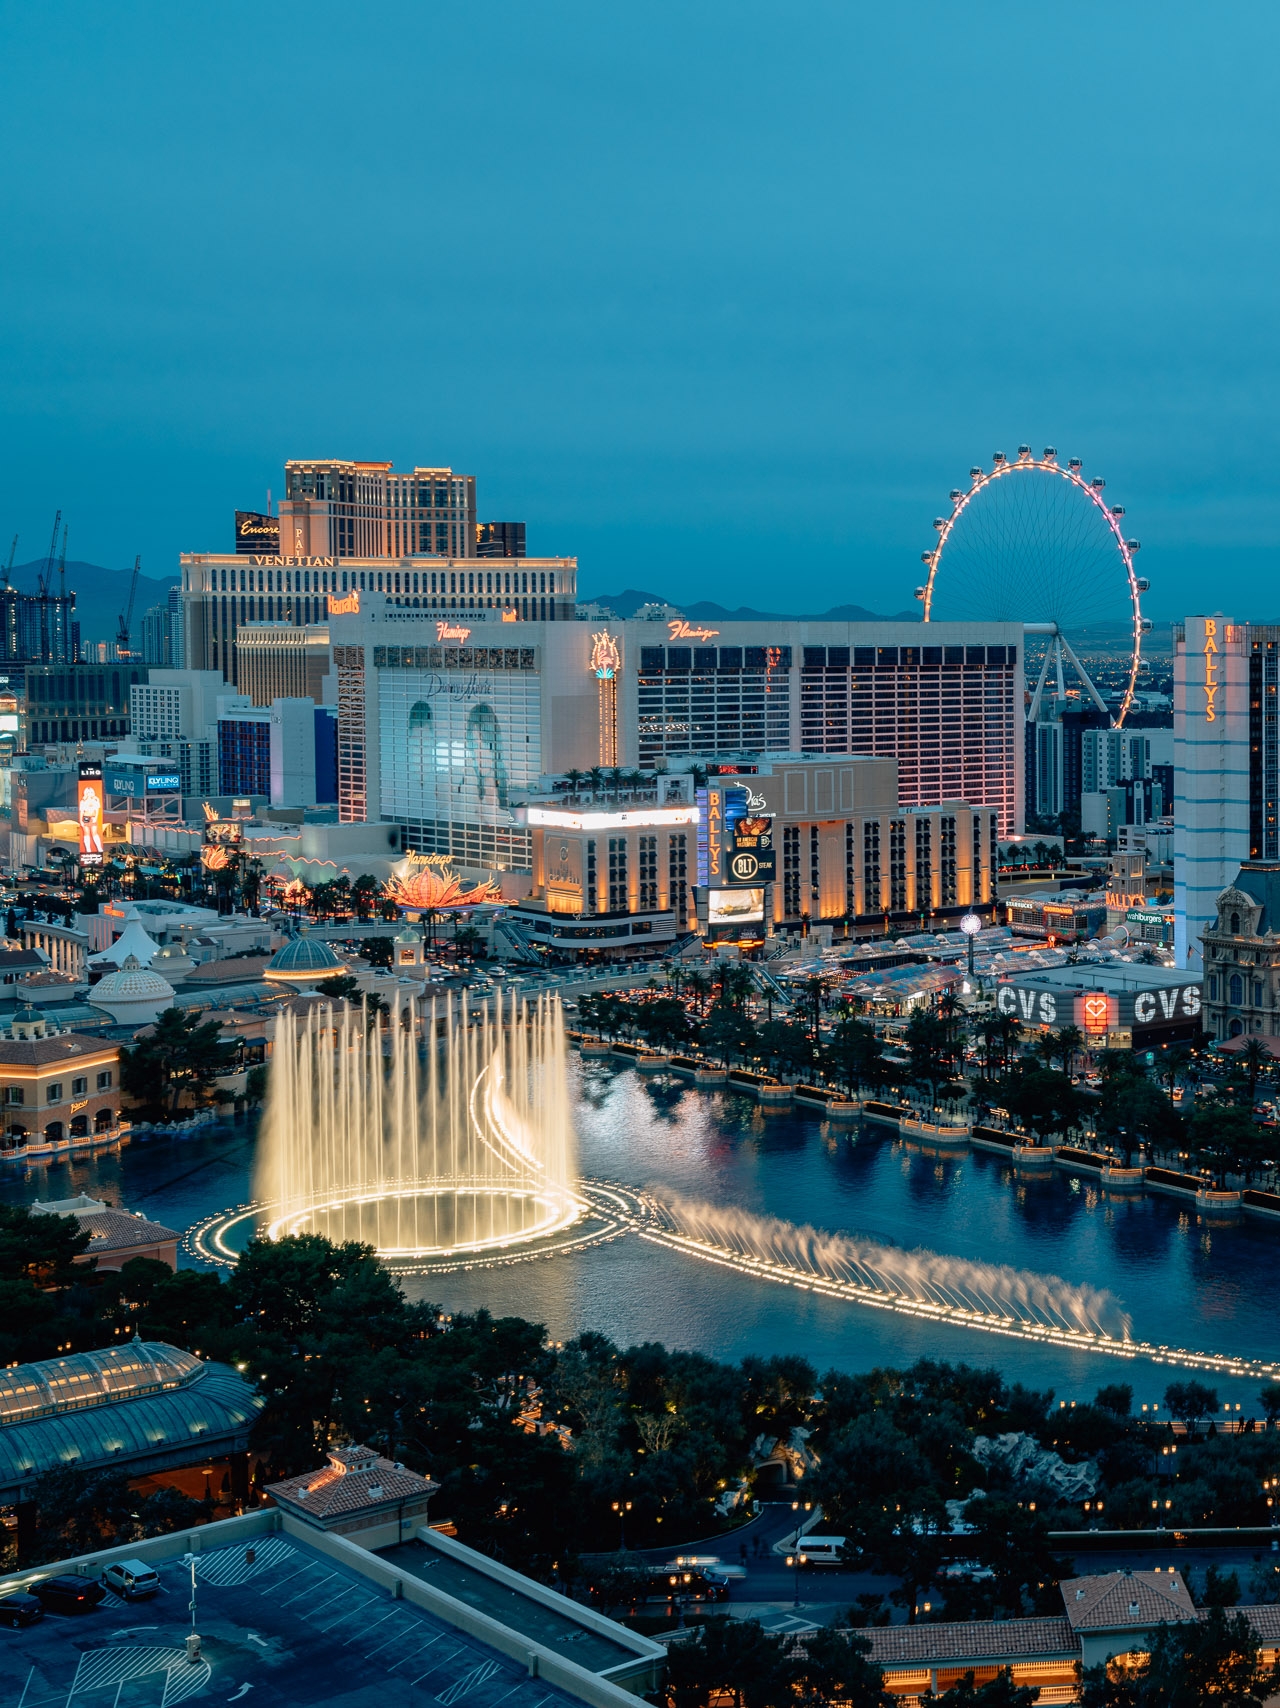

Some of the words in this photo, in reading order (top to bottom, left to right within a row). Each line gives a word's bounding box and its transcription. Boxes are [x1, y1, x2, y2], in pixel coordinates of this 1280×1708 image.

[240, 520, 280, 535] Encore
[254, 555, 335, 567] VENETIAN
[436, 621, 471, 644] Flamingo
[667, 620, 720, 642] Flamingo
[1203, 619, 1218, 722] BALLYS
[708, 792, 721, 875] BALLYS
[405, 849, 455, 866] Flamingo
[738, 859, 753, 874] BLT
[1005, 901, 1033, 909] STARBUCKS
[1126, 913, 1162, 924] wahlburgers
[998, 986, 1057, 1023] CVS
[1135, 986, 1201, 1023] CVS
